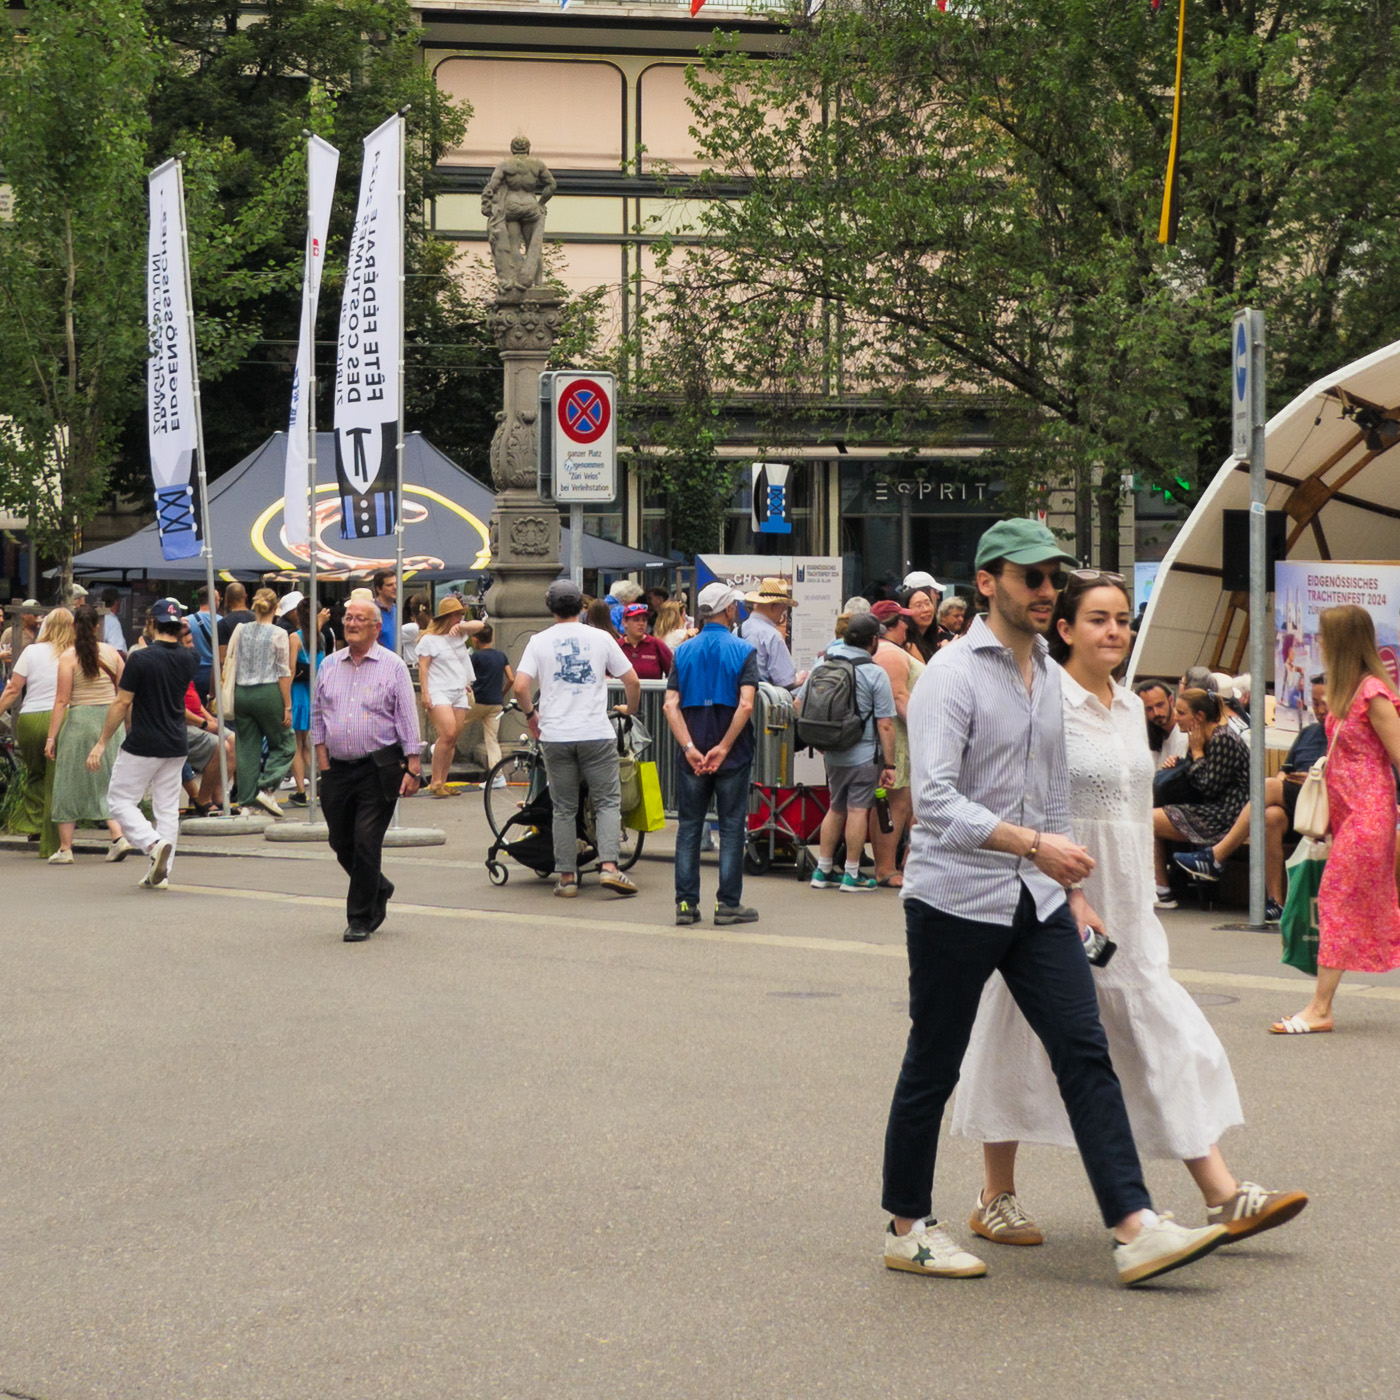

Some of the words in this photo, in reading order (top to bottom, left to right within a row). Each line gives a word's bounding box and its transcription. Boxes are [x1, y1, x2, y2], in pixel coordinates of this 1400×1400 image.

[588, 449, 602, 457] Platz
[572, 462, 605, 471] genommen
[560, 483, 569, 492] bei
[1307, 574, 1379, 590] EIDGENÖSSISCHES
[1307, 589, 1366, 604] TRACHTENFEST
[1367, 593, 1387, 605] 2024
